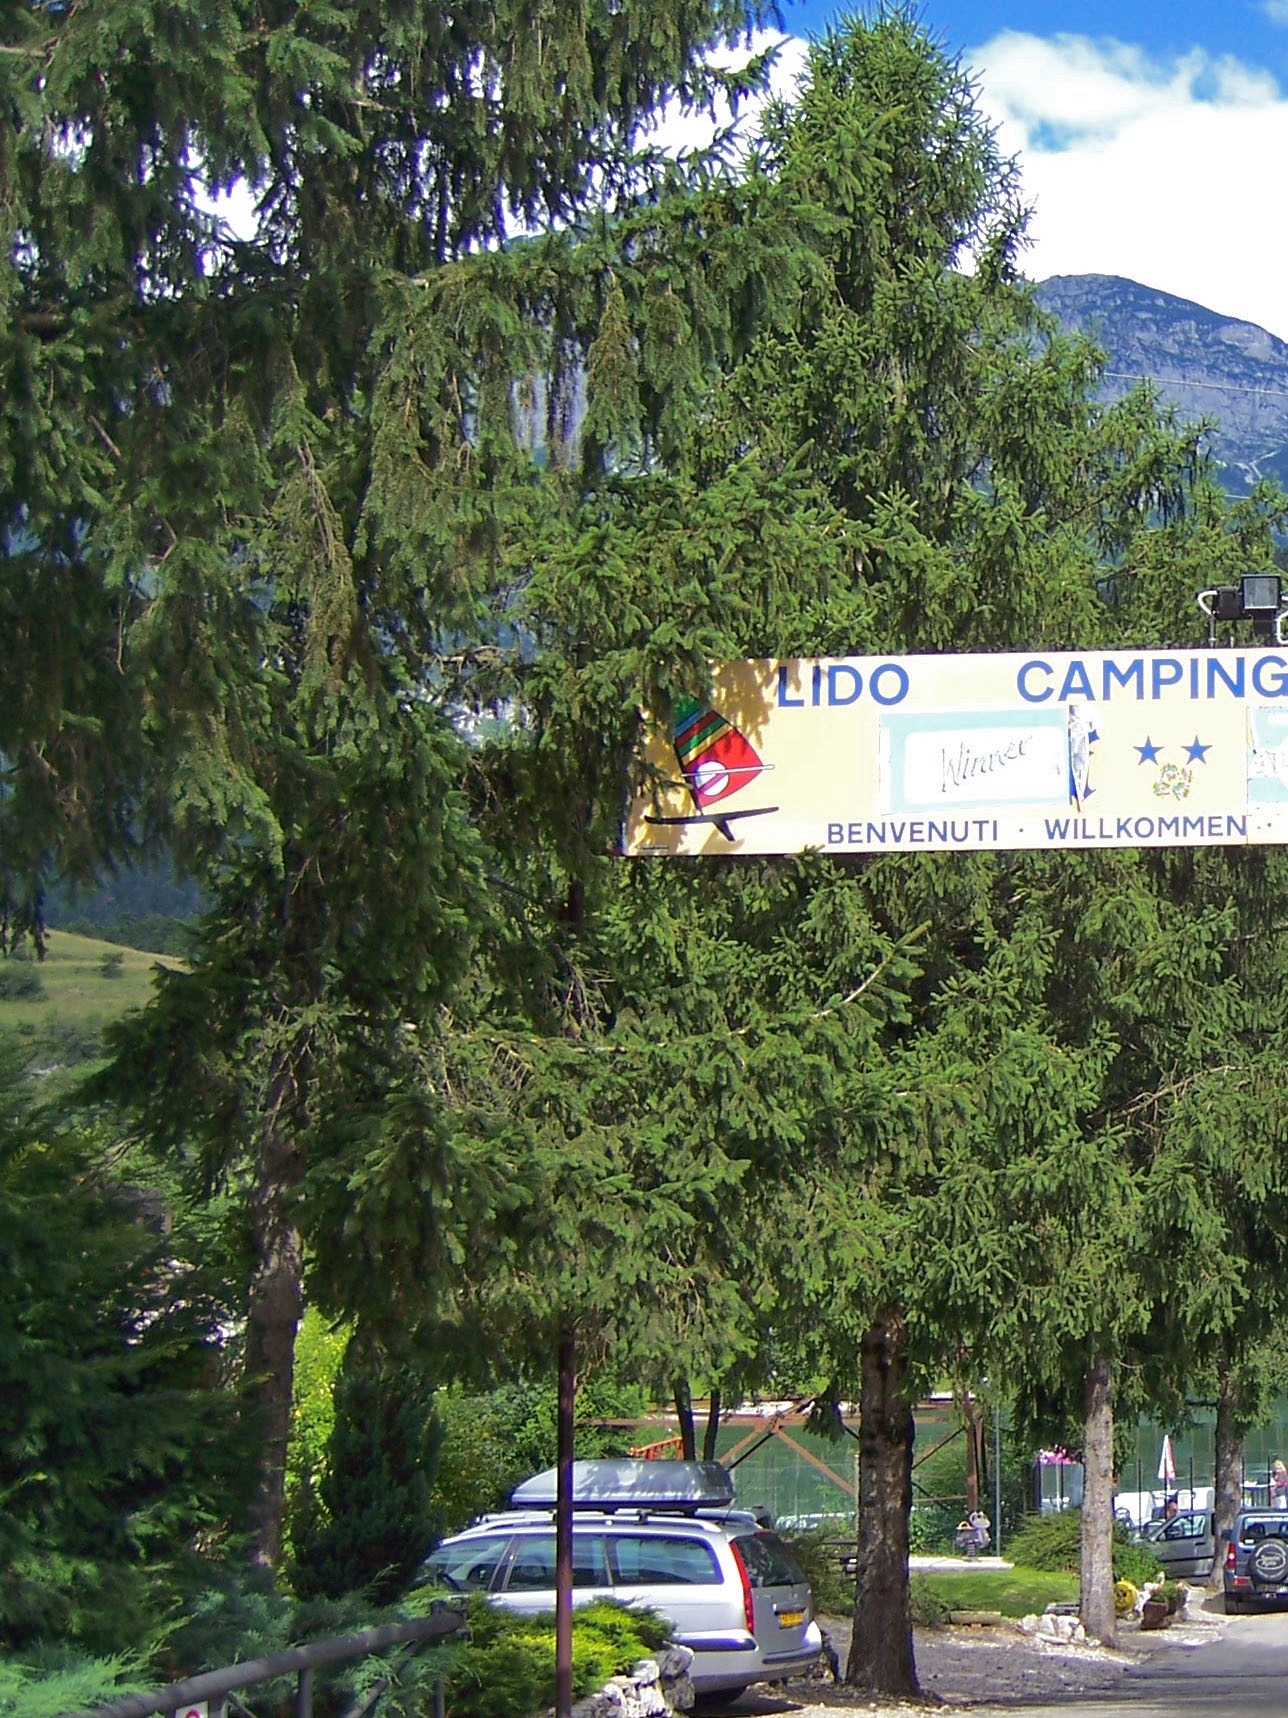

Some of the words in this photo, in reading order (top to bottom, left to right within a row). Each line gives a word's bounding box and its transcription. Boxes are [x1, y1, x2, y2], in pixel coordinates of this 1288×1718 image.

[778, 663, 909, 707] LIDO
[942, 734, 1032, 792] Winner
[827, 819, 998, 844] BENVENUTI
[1044, 815, 1247, 840] WILLKOMMEN
